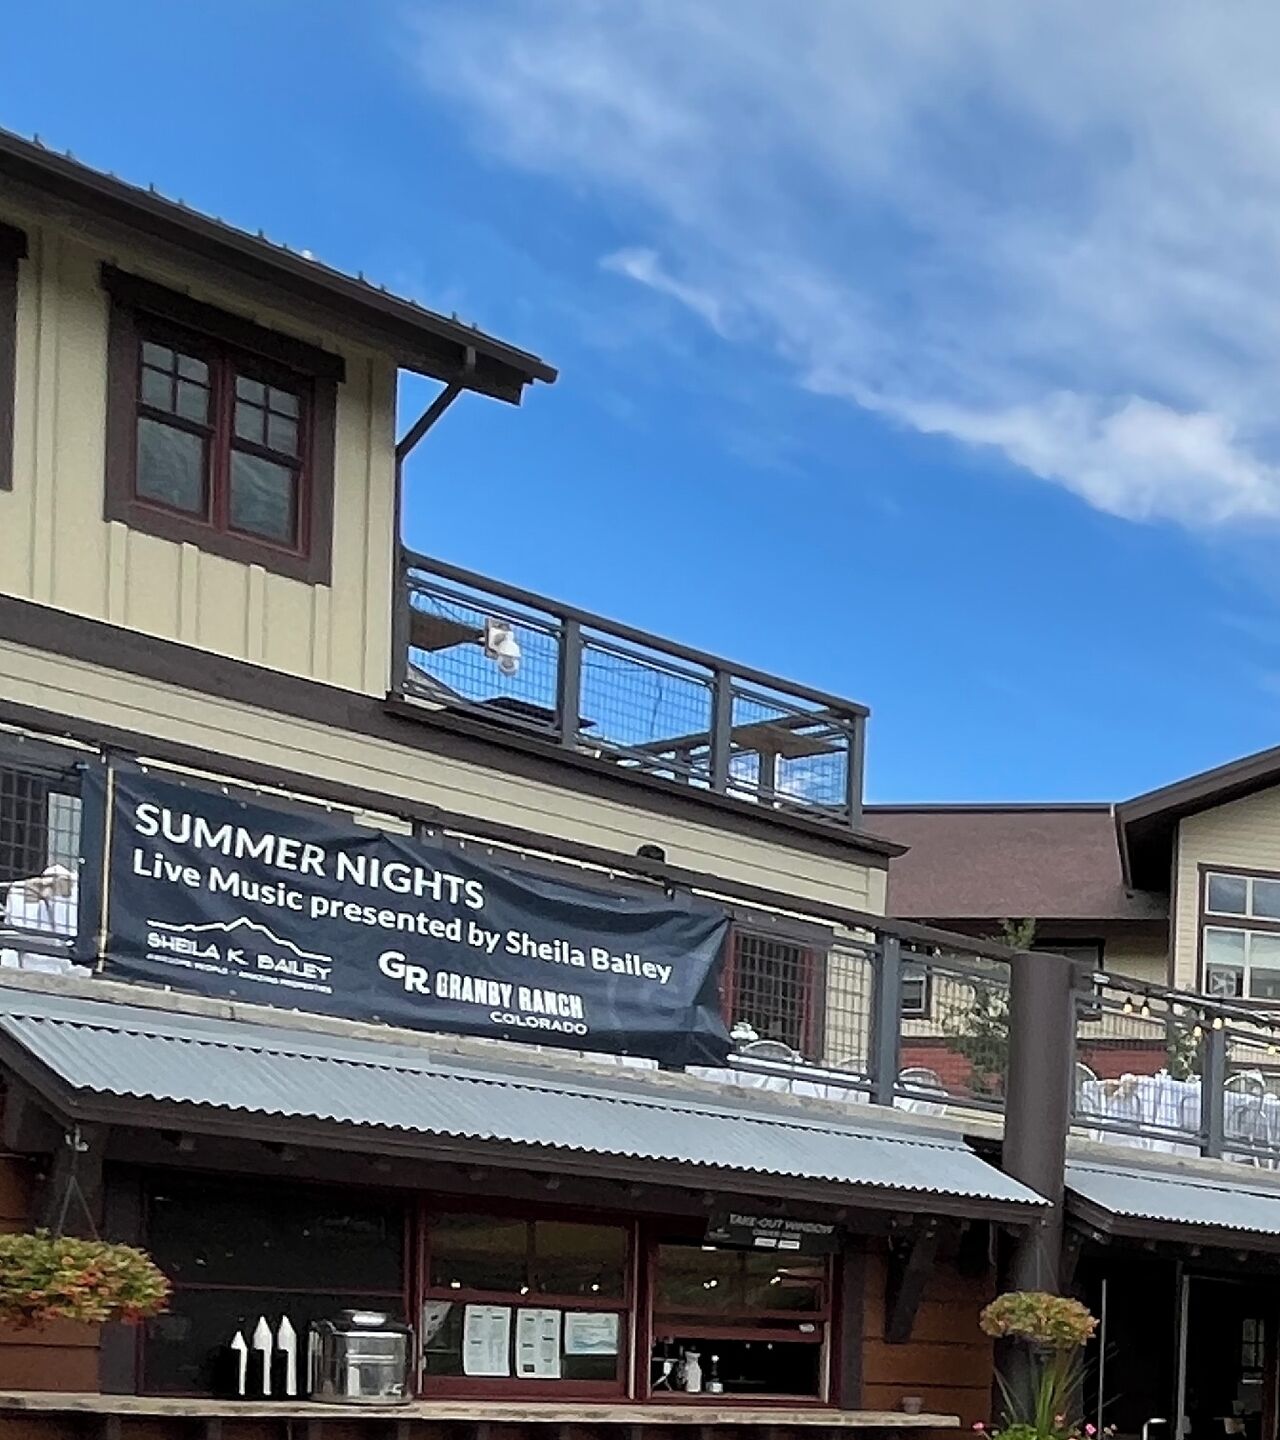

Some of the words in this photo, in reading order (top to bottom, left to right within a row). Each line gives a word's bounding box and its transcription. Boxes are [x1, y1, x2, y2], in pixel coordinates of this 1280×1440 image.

[134, 802, 326, 877] SUMMER
[335, 850, 485, 909] NIGHTS
[133, 849, 201, 887] Live
[208, 867, 302, 911] Music
[311, 894, 461, 942] presented
[468, 921, 501, 954] by
[505, 930, 586, 968] Sheila
[590, 948, 673, 985] Bailey
[147, 932, 220, 961] SHEILA
[257, 954, 332, 981] BAILEY
[378, 951, 430, 994] GR
[436, 971, 513, 1009] GRANBY
[518, 986, 585, 1019] RANCH
[489, 1011, 588, 1036] COLORADO
